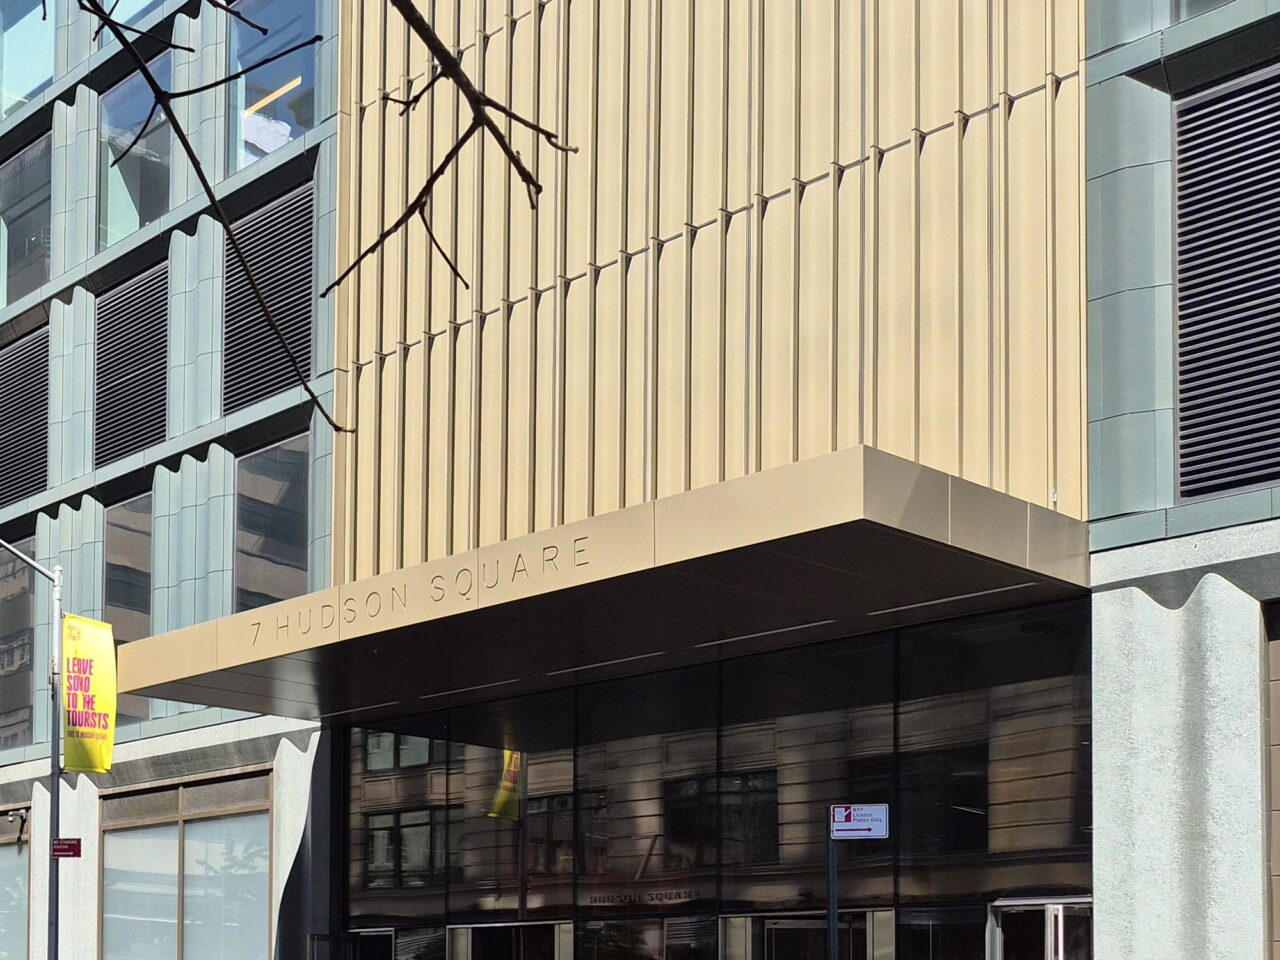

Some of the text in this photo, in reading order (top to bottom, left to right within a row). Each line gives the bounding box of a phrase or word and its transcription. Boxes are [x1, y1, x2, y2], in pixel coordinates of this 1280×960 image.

[251, 536, 589, 646] 7 HUDSON SQUARE
[66, 657, 94, 675] LEAVE
[66, 692, 77, 710] TO
